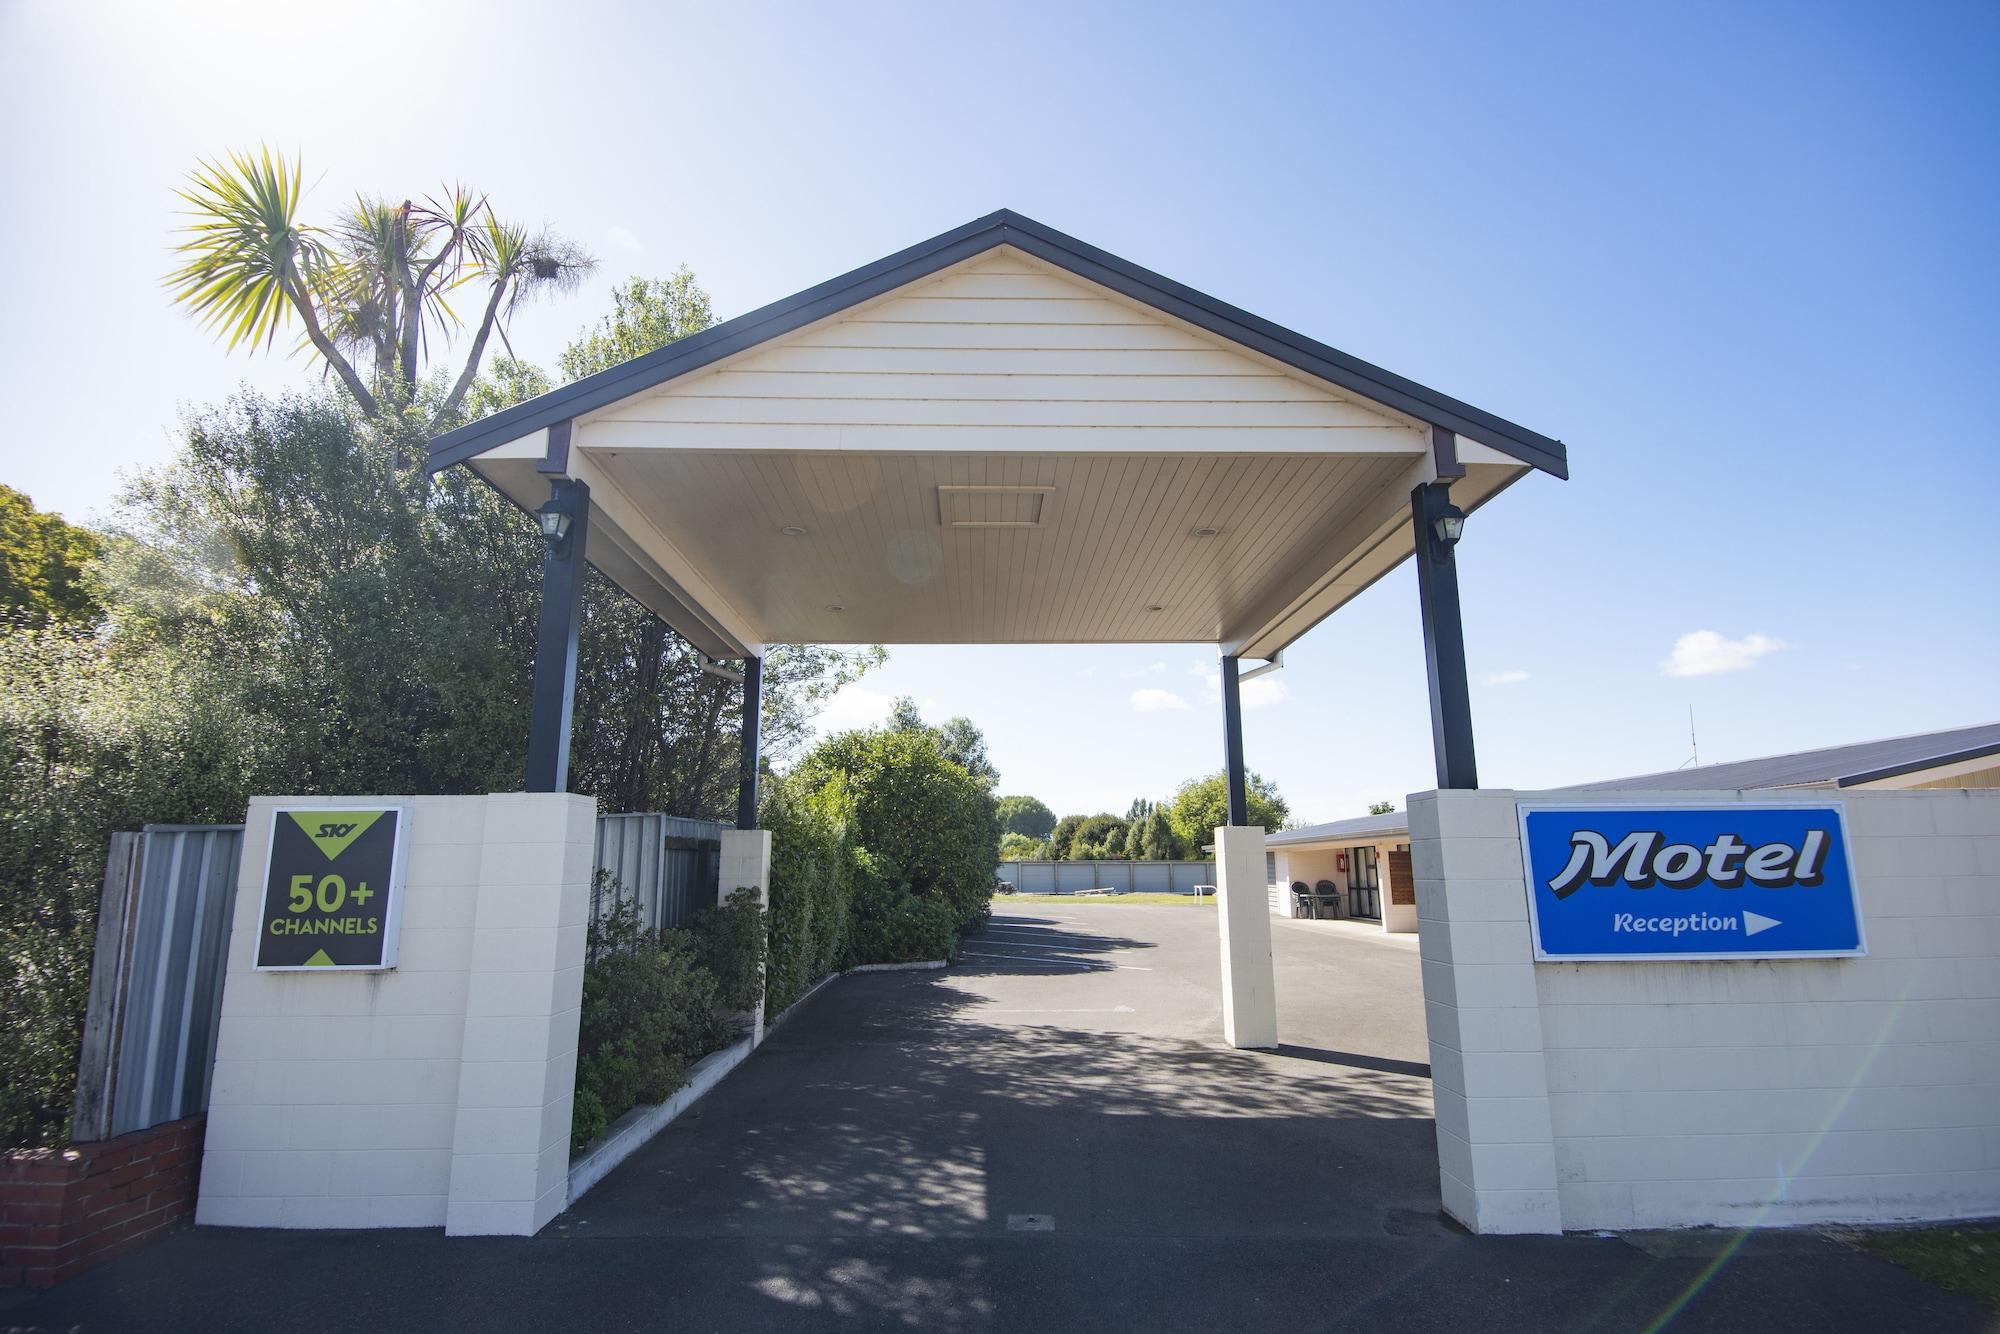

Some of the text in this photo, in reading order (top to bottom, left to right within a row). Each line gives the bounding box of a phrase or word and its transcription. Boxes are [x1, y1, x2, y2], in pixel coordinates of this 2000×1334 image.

[315, 823, 358, 838] SKY
[1548, 829, 1830, 900] Motel
[288, 874, 374, 913] 50+
[270, 917, 378, 935] CHANNELS
[1614, 911, 1738, 937] Reception
